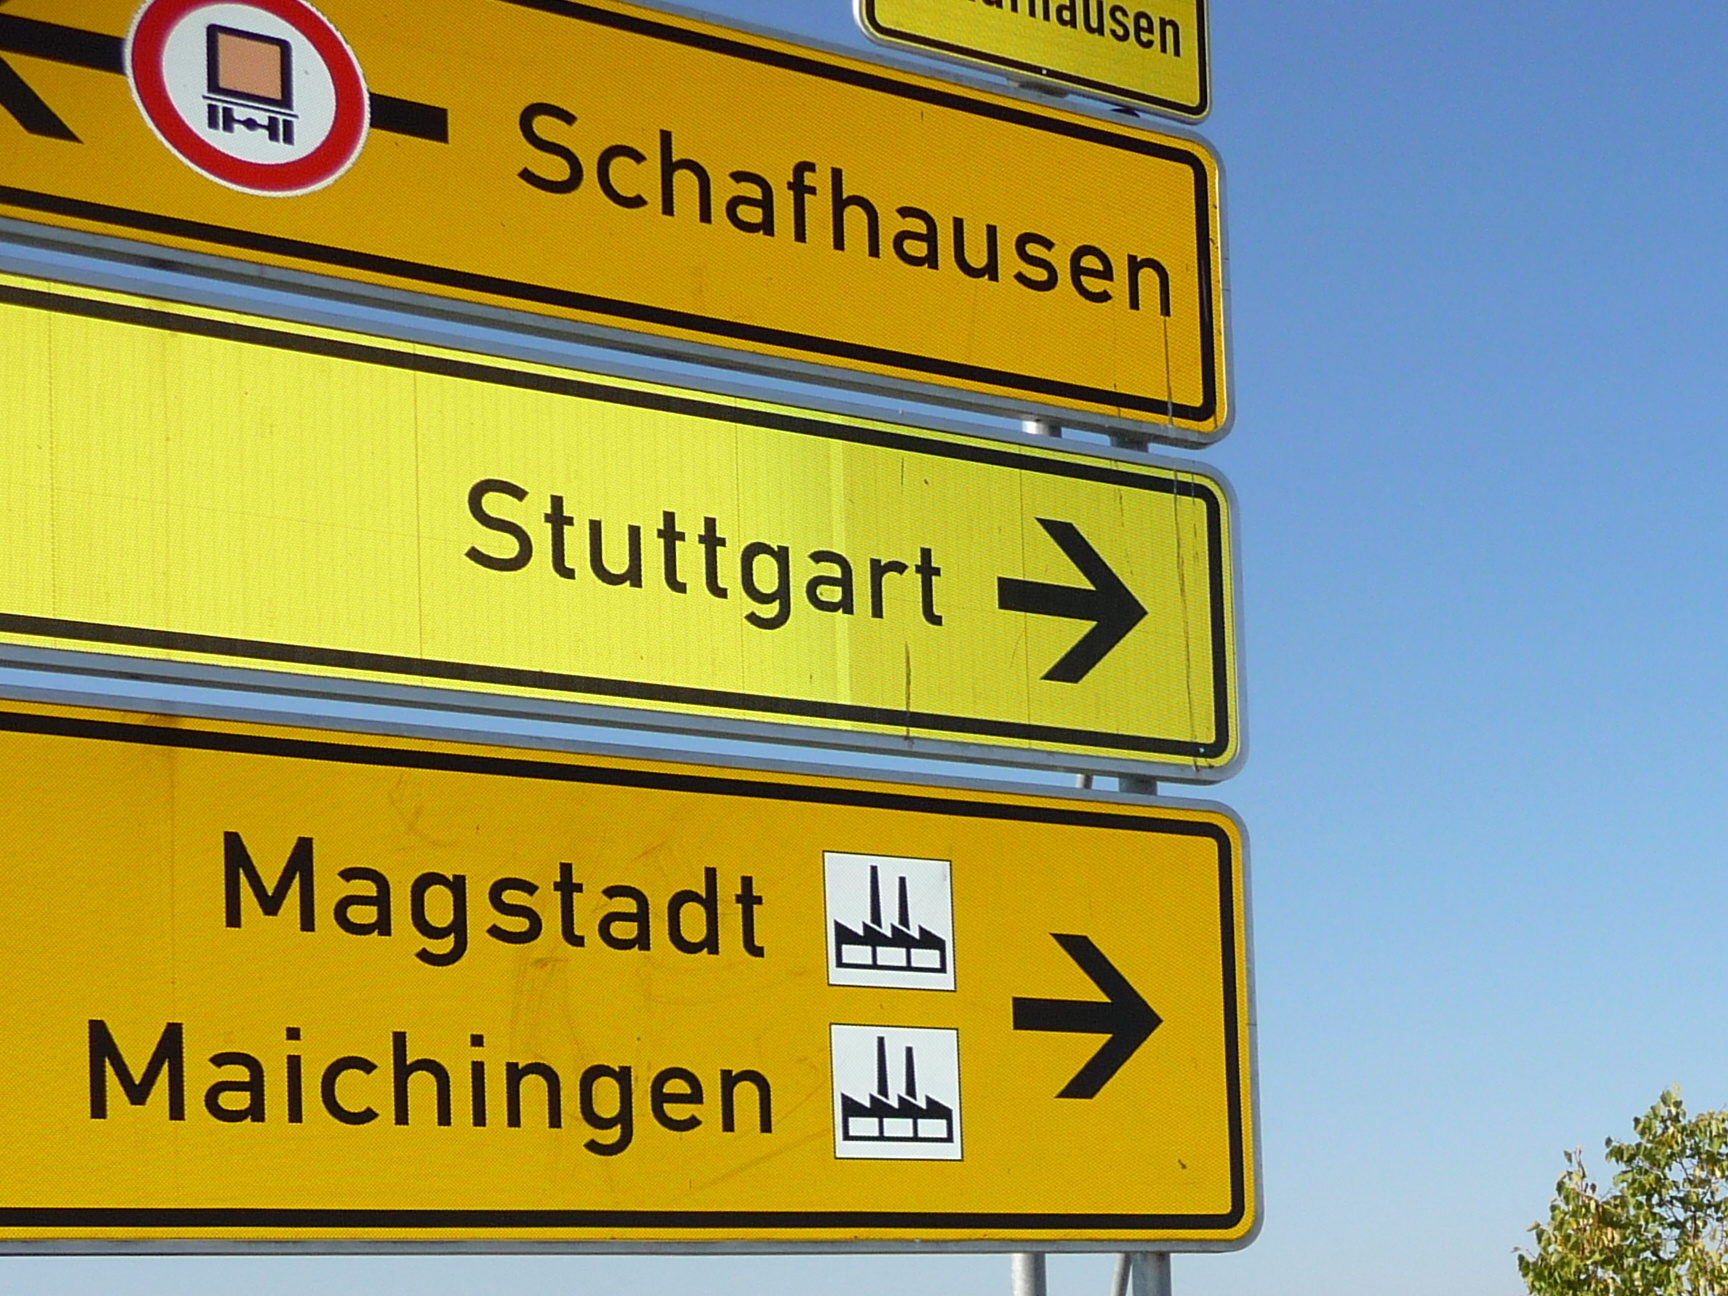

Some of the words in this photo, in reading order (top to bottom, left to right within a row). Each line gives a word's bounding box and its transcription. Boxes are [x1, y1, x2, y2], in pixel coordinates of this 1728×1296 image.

[518, 103, 1171, 318] Schafhausen
[465, 479, 943, 631] Stuttgart
[224, 831, 765, 967] Magstadt
[89, 1019, 773, 1157] Maichingen
